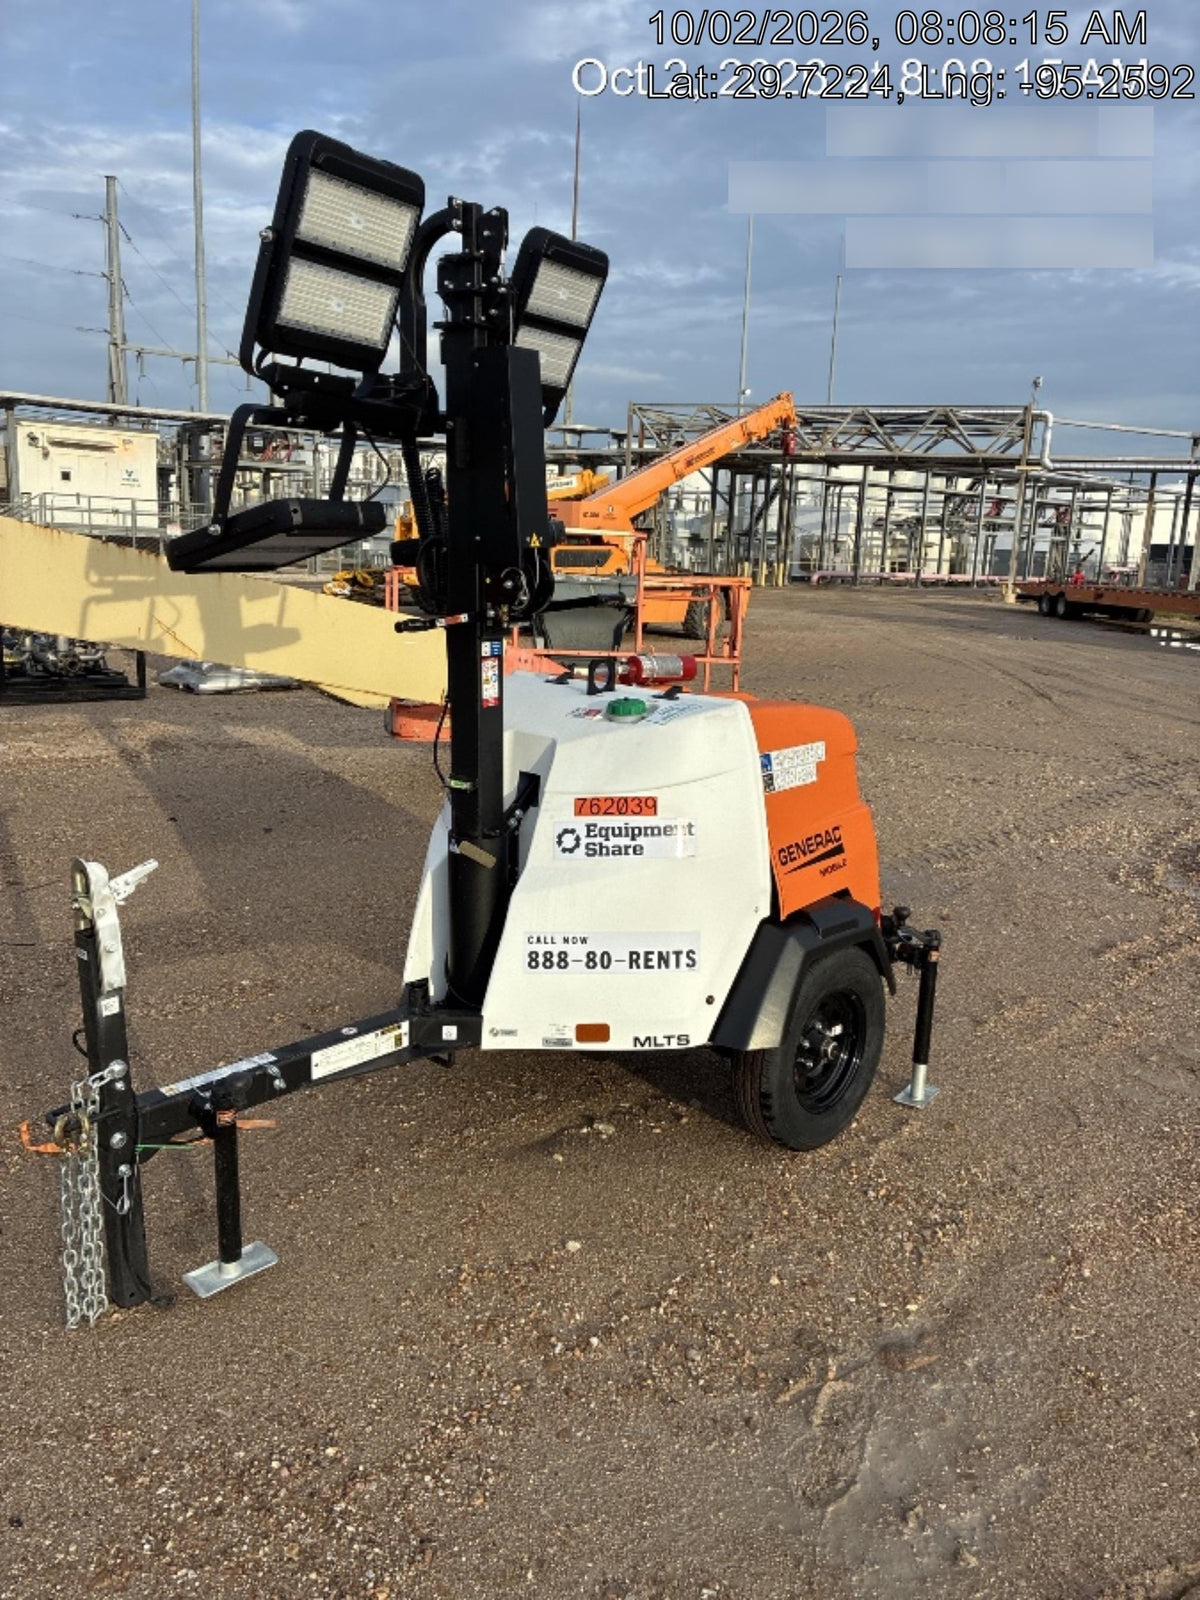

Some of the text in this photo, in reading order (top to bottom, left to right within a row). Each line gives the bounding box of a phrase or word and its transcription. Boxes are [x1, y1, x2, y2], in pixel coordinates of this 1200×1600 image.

[577, 797, 658, 816] 762039
[585, 823, 695, 842] Equipmet
[585, 842, 645, 858] Share
[778, 825, 842, 866] GENERAC
[527, 936, 589, 945] CALL NOW
[527, 949, 698, 971] 888-80-RENTS
[632, 1034, 691, 1048] MLTS
